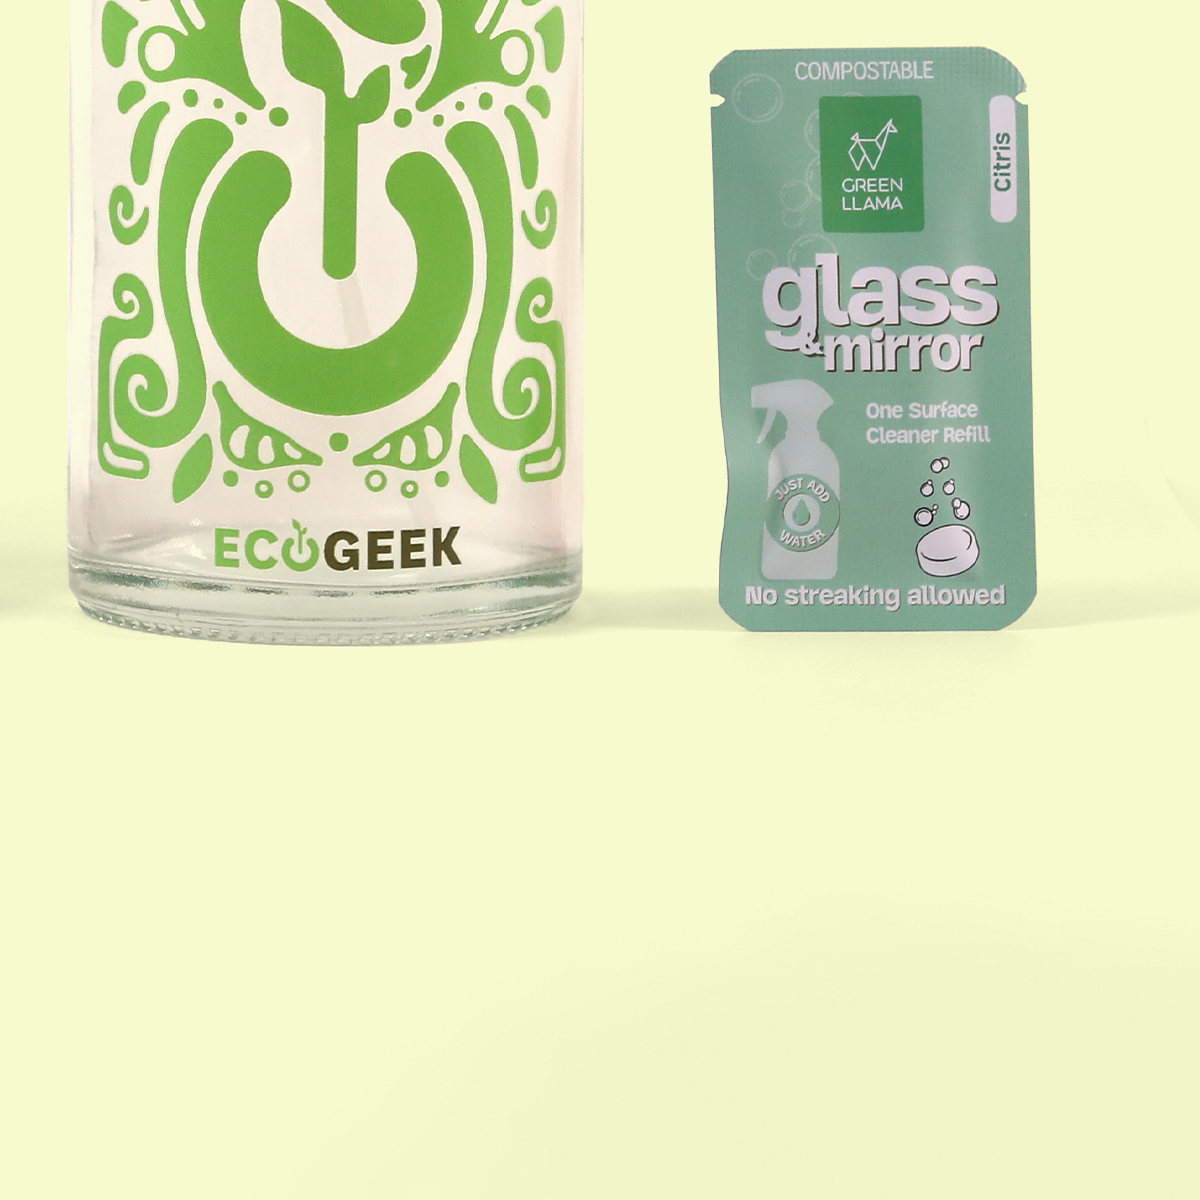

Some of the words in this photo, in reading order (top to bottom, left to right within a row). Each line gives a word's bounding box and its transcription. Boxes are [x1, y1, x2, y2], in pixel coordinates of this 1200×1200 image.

[795, 61, 934, 81] COMPOSTABLE
[994, 131, 1012, 192] Citris
[842, 177, 903, 193] GREEN
[842, 196, 903, 211] LLAMA
[762, 253, 999, 351] glass
[866, 402, 903, 420] One
[909, 401, 978, 420] Surface
[866, 426, 939, 444] Cleaner
[944, 426, 991, 444] Refill
[774, 478, 804, 502] JUST
[806, 479, 832, 504] ADD
[214, 518, 462, 573] ECOGEEK
[780, 529, 826, 548] WATER
[745, 586, 782, 605] No
[789, 586, 900, 608] streaking
[907, 585, 1006, 606] allowed
